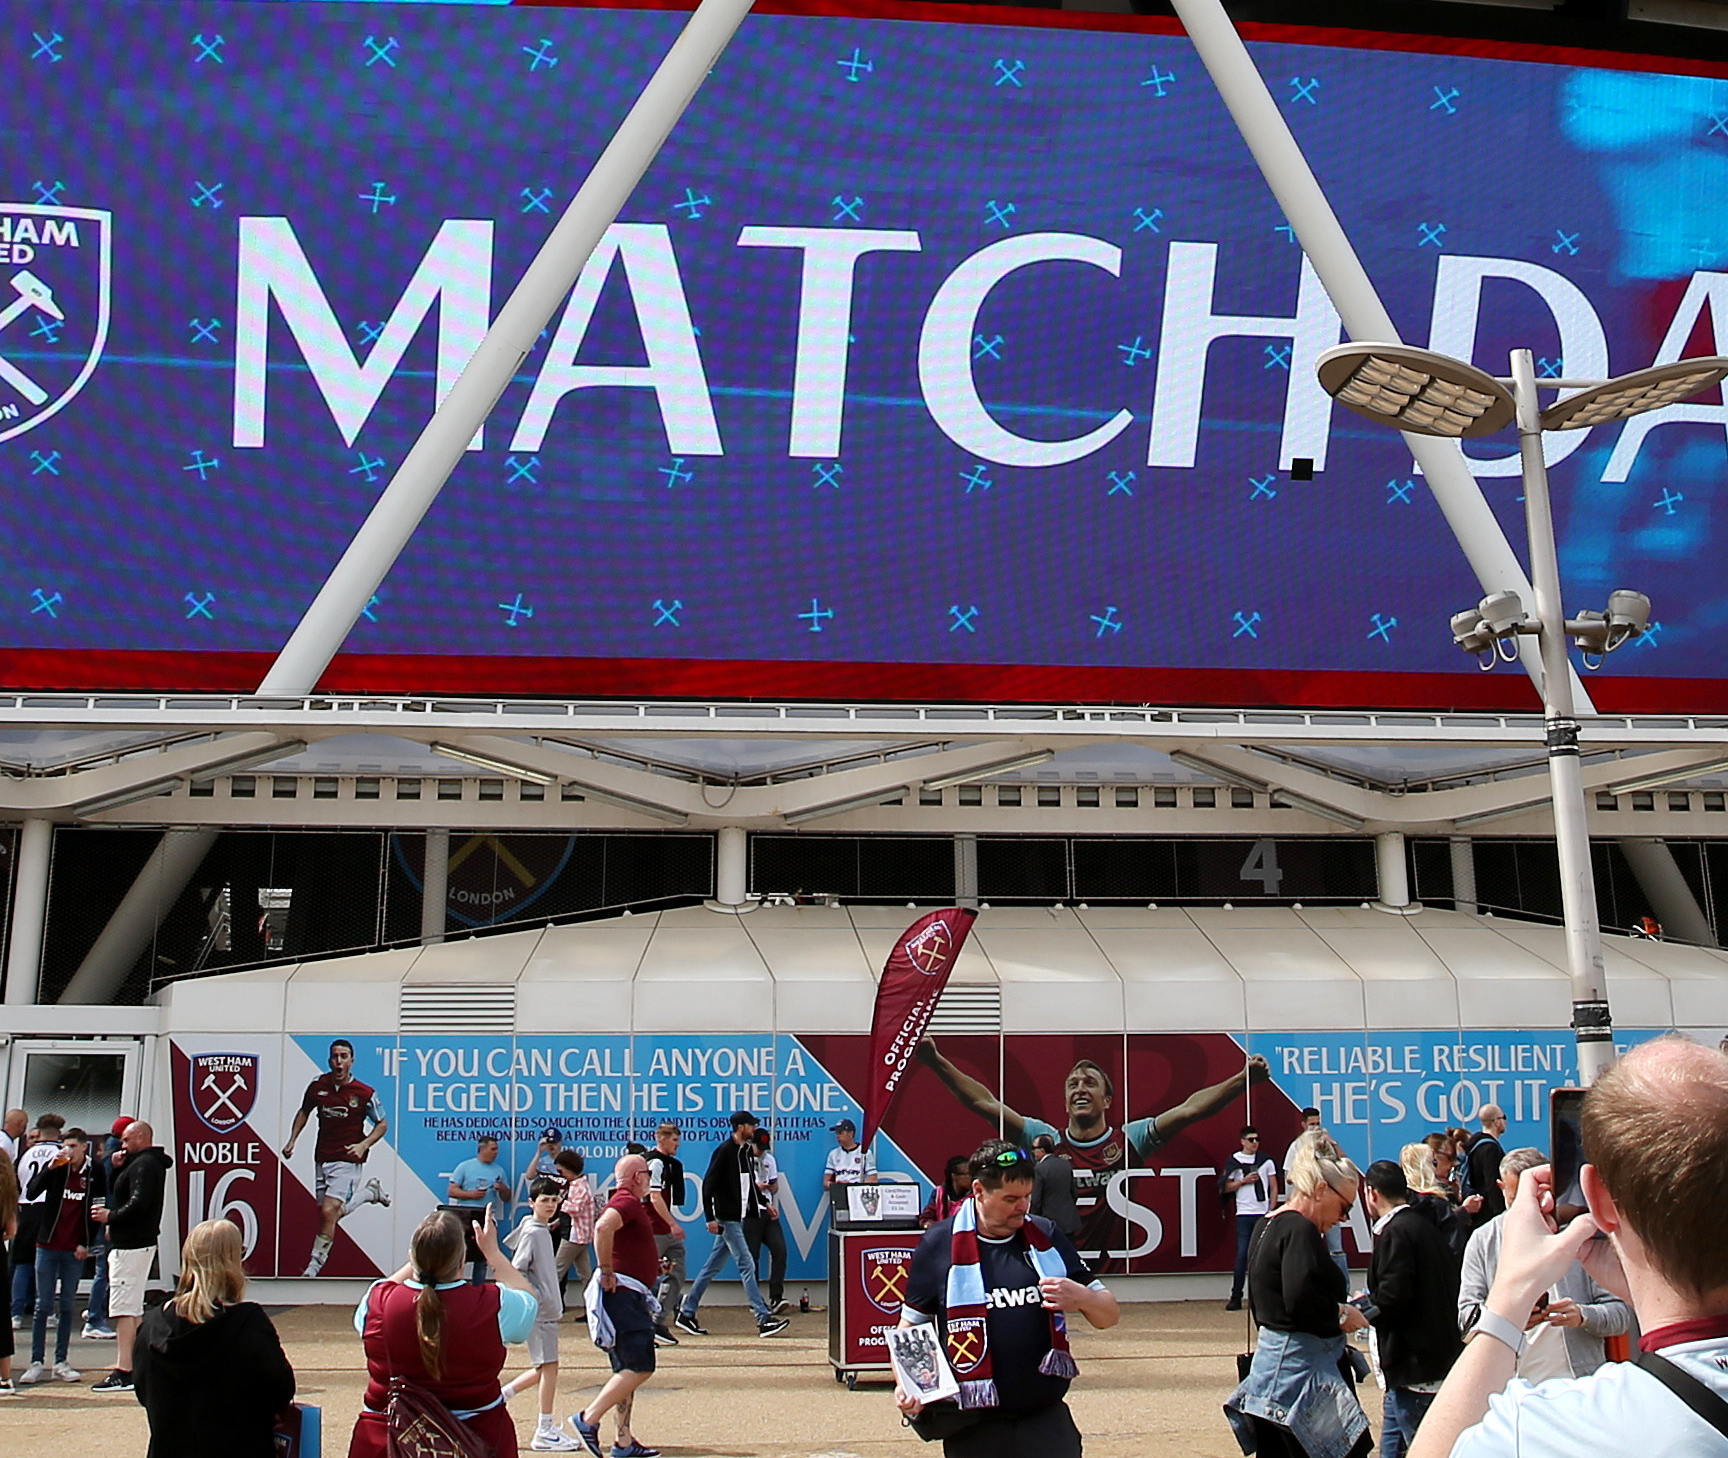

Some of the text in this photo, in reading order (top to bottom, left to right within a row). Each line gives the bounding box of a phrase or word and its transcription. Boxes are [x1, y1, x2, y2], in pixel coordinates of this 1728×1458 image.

[1239, 837, 1284, 894] 4
[448, 886, 515, 905] LONDON
[883, 1000, 925, 1066] OFFICIAL
[198, 1056, 252, 1067] WEST HAM
[209, 1064, 241, 1073] UNITED
[414, 1047, 480, 1077] YOU
[485, 1047, 553, 1077] CAN
[558, 1047, 642, 1077] CALL
[648, 1047, 778, 1077] ANYONE
[784, 1047, 807, 1077] A
[1433, 1044, 1571, 1077] RESILIENT,
[407, 1082, 850, 1113] LEGEND THEN HE IS THE ONE.
[1312, 1079, 1548, 1125] HE'S GOT IT
[424, 1116, 439, 1129] HE
[440, 1116, 464, 1129] HAS
[466, 1116, 530, 1129] DEDICATED
[531, 1116, 547, 1129] SO
[548, 1116, 583, 1129] MUCH
[585, 1116, 601, 1129] TO
[602, 1116, 622, 1129] THE
[625, 1116, 657, 1129] CLUB
[659, 1116, 684, 1129] AND
[685, 1116, 695, 1129] IT
[697, 1116, 707, 1129] IS
[802, 1116, 826, 1129] HAS
[437, 1130, 466, 1142] BEEN
[467, 1130, 485, 1142] AN
[486, 1130, 535, 1142] HONOUR
[564, 1130, 573, 1142] A
[574, 1130, 631, 1142] PRIVILEGE
[633, 1130, 656, 1142] FOR
[682, 1130, 697, 1142] TO
[698, 1130, 728, 1142] PLAY
[183, 1142, 261, 1164] NOBLE
[605, 1145, 618, 1159] DI
[187, 1168, 260, 1263] 16
[867, 1251, 912, 1261] WEST HAM
